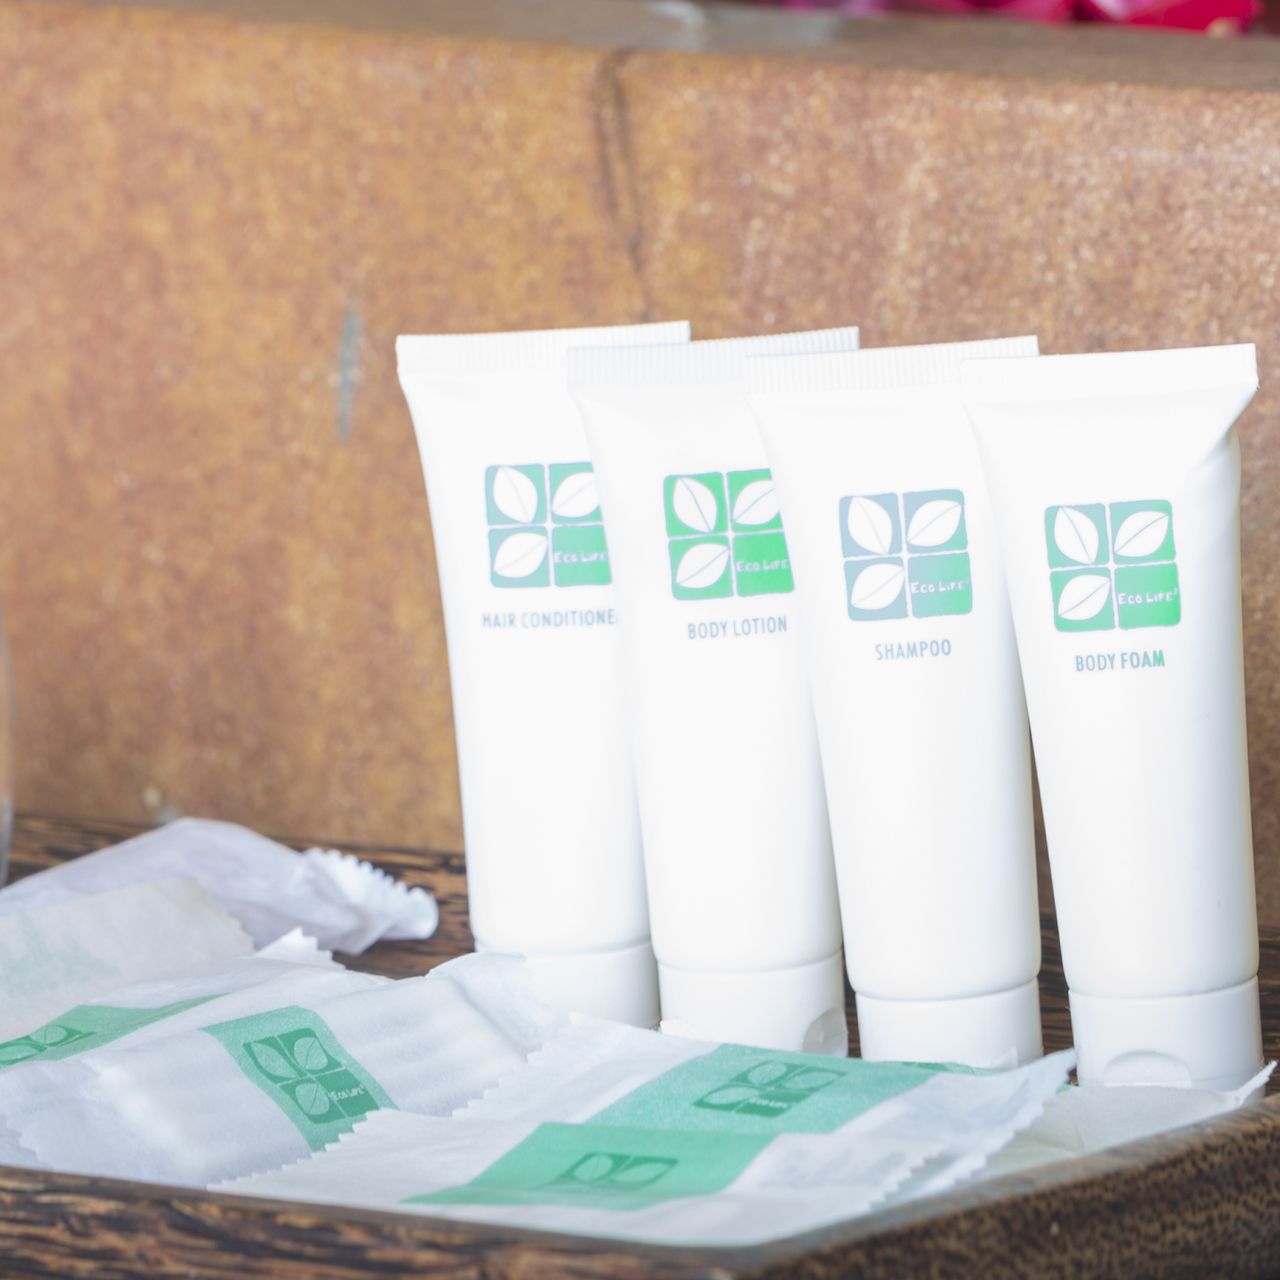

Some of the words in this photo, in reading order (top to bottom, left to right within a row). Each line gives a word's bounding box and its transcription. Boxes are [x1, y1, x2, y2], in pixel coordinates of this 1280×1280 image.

[482, 611, 517, 628] HAIR
[521, 608, 618, 628] CONDITIONE
[687, 621, 728, 640] BODY
[732, 615, 788, 637] LOTION
[875, 638, 952, 661] SHAMPOO
[1075, 653, 1116, 673] BODY
[1120, 649, 1166, 670] FOAM
